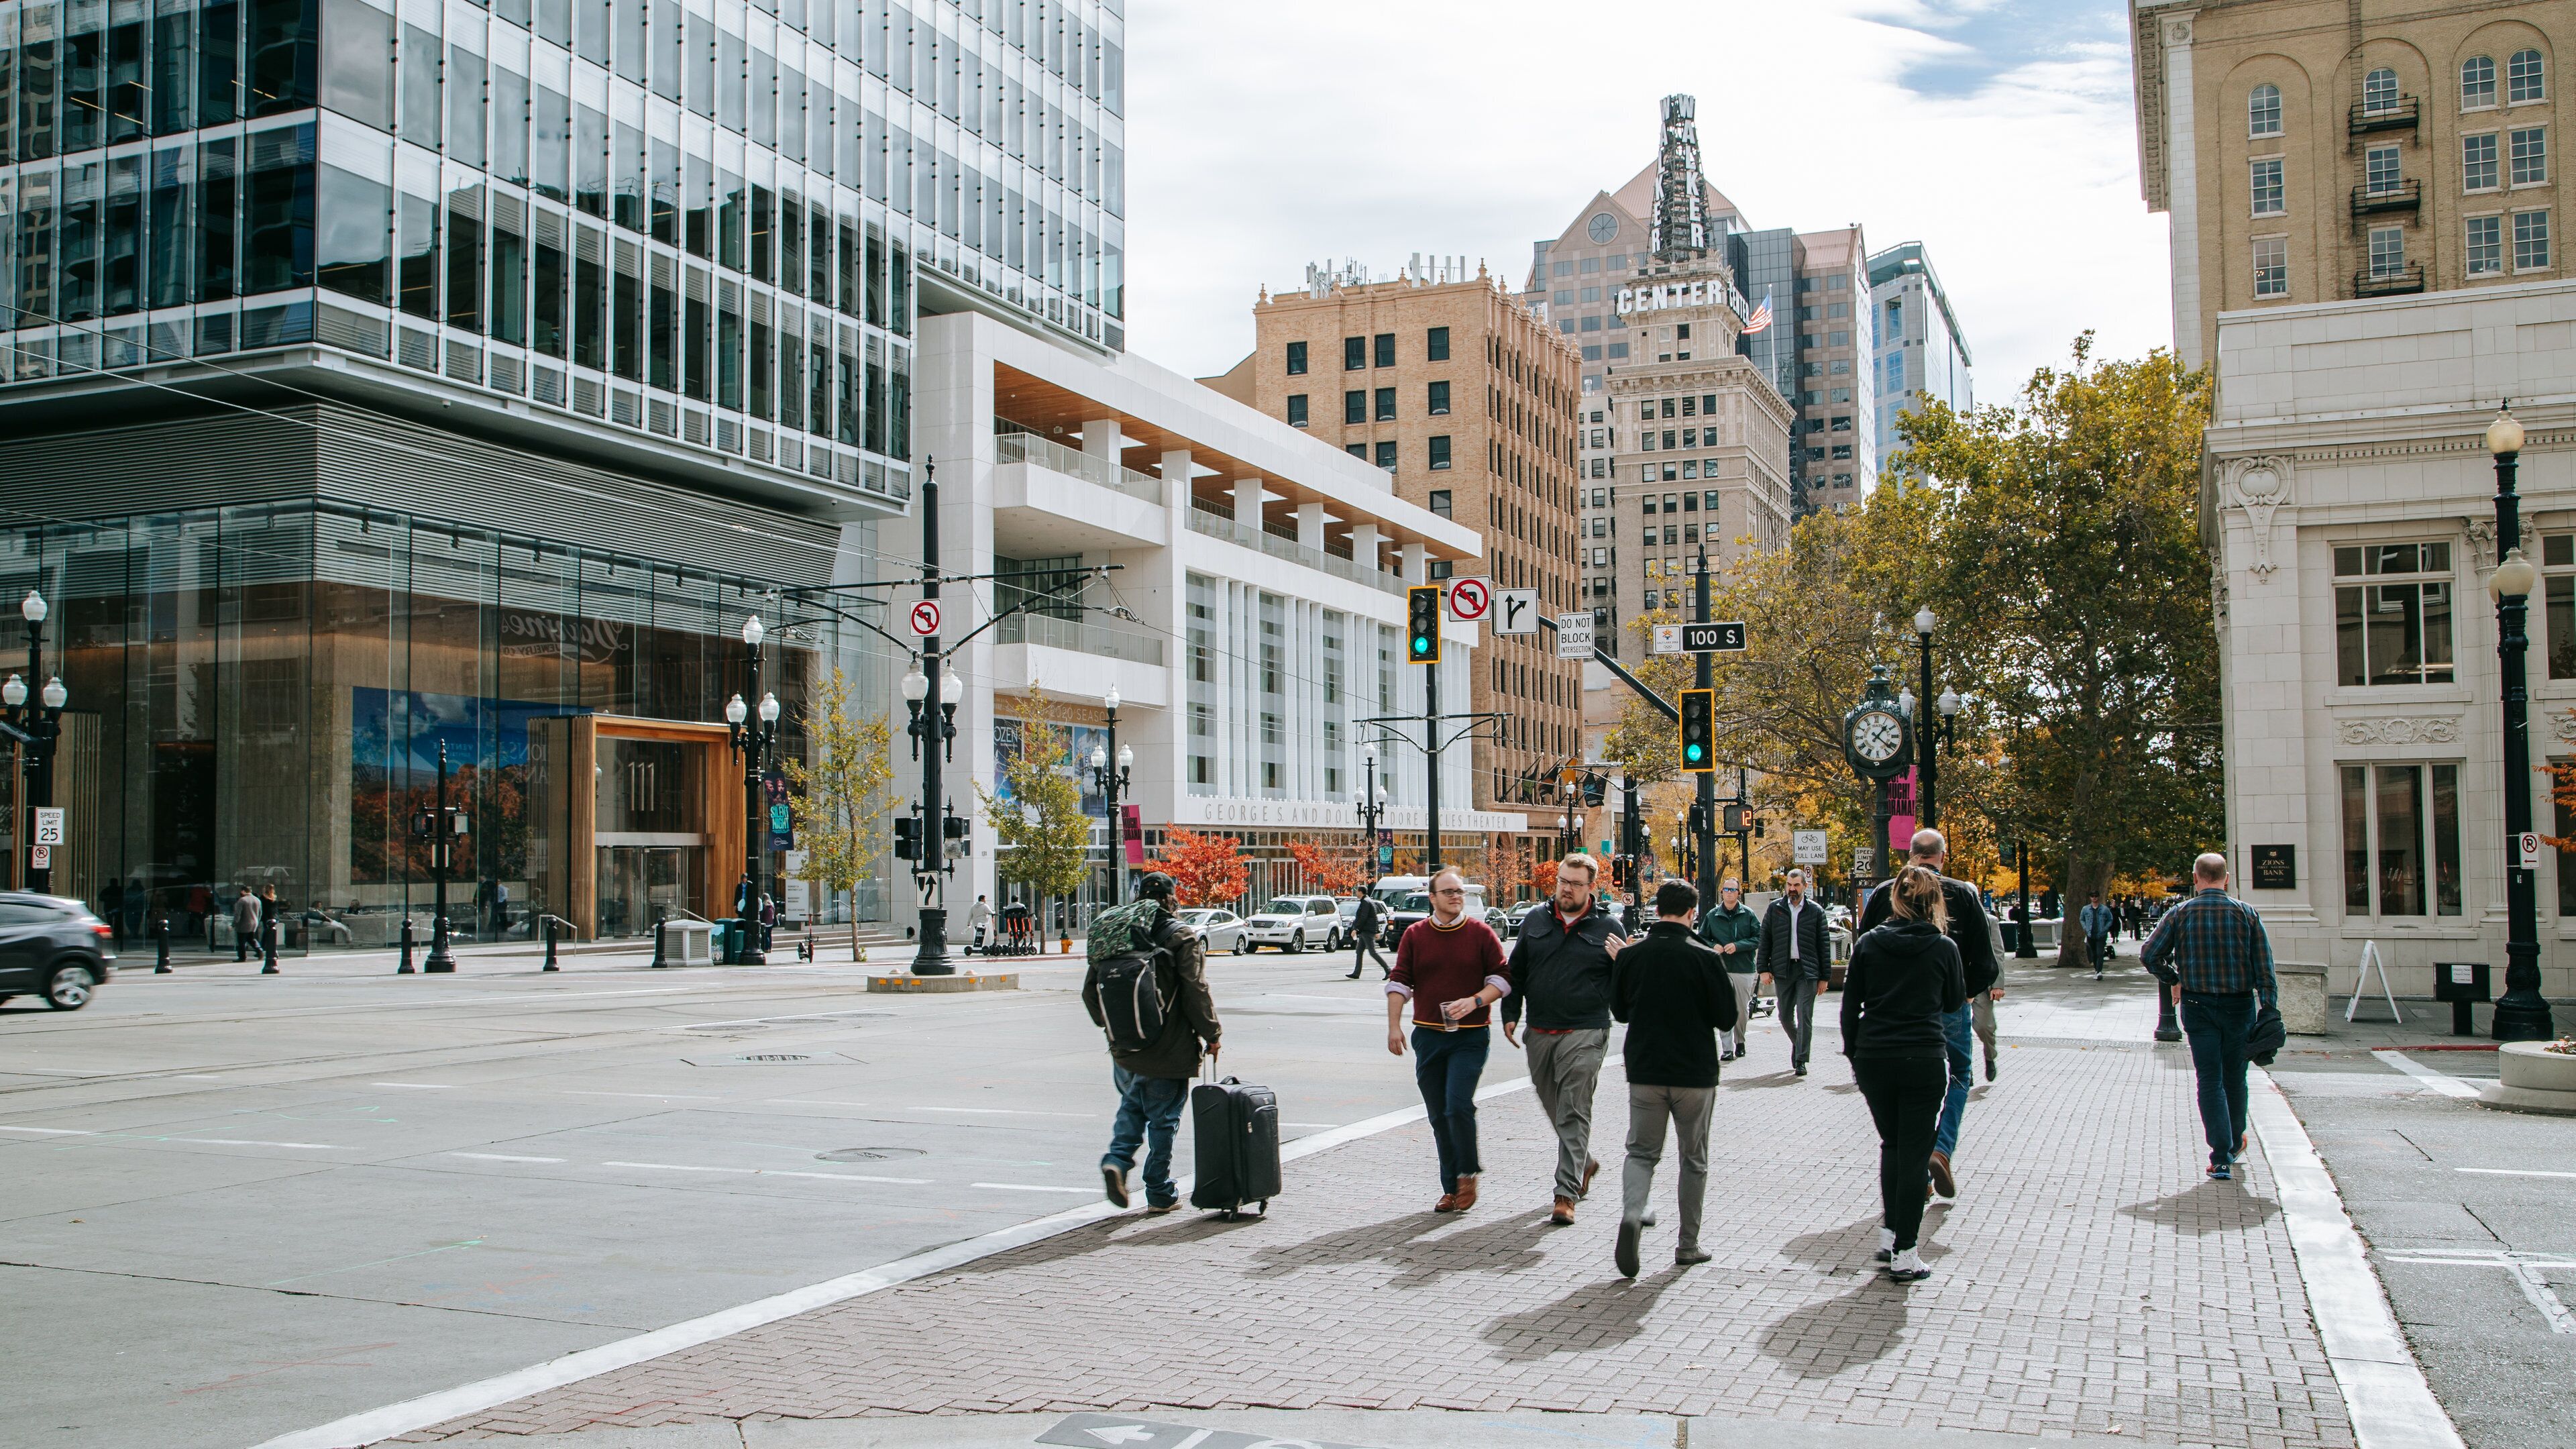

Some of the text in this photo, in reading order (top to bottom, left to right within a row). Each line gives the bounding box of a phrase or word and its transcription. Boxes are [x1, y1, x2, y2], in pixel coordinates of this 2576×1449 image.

[1677, 93, 1705, 248] WALKER
[1617, 280, 1723, 315] CENTER
[1561, 618, 1591, 629] DO NOT
[1561, 633, 1591, 643] BLOCK
[1690, 630, 1739, 645] 100 S.
[1561, 645, 1591, 653] INTERSECTION
[1076, 708, 1108, 722] SEASO
[628, 761, 654, 811] 111
[770, 806, 789, 818] SILENT
[1205, 804, 1269, 822] GEORGE
[1292, 807, 1318, 823] AND
[1425, 813, 1462, 827] ECLES
[1467, 814, 1507, 829] THEATER
[1742, 810, 1752, 826] 12
[772, 818, 790, 830] NIGHT
[41, 828, 58, 841] 25
